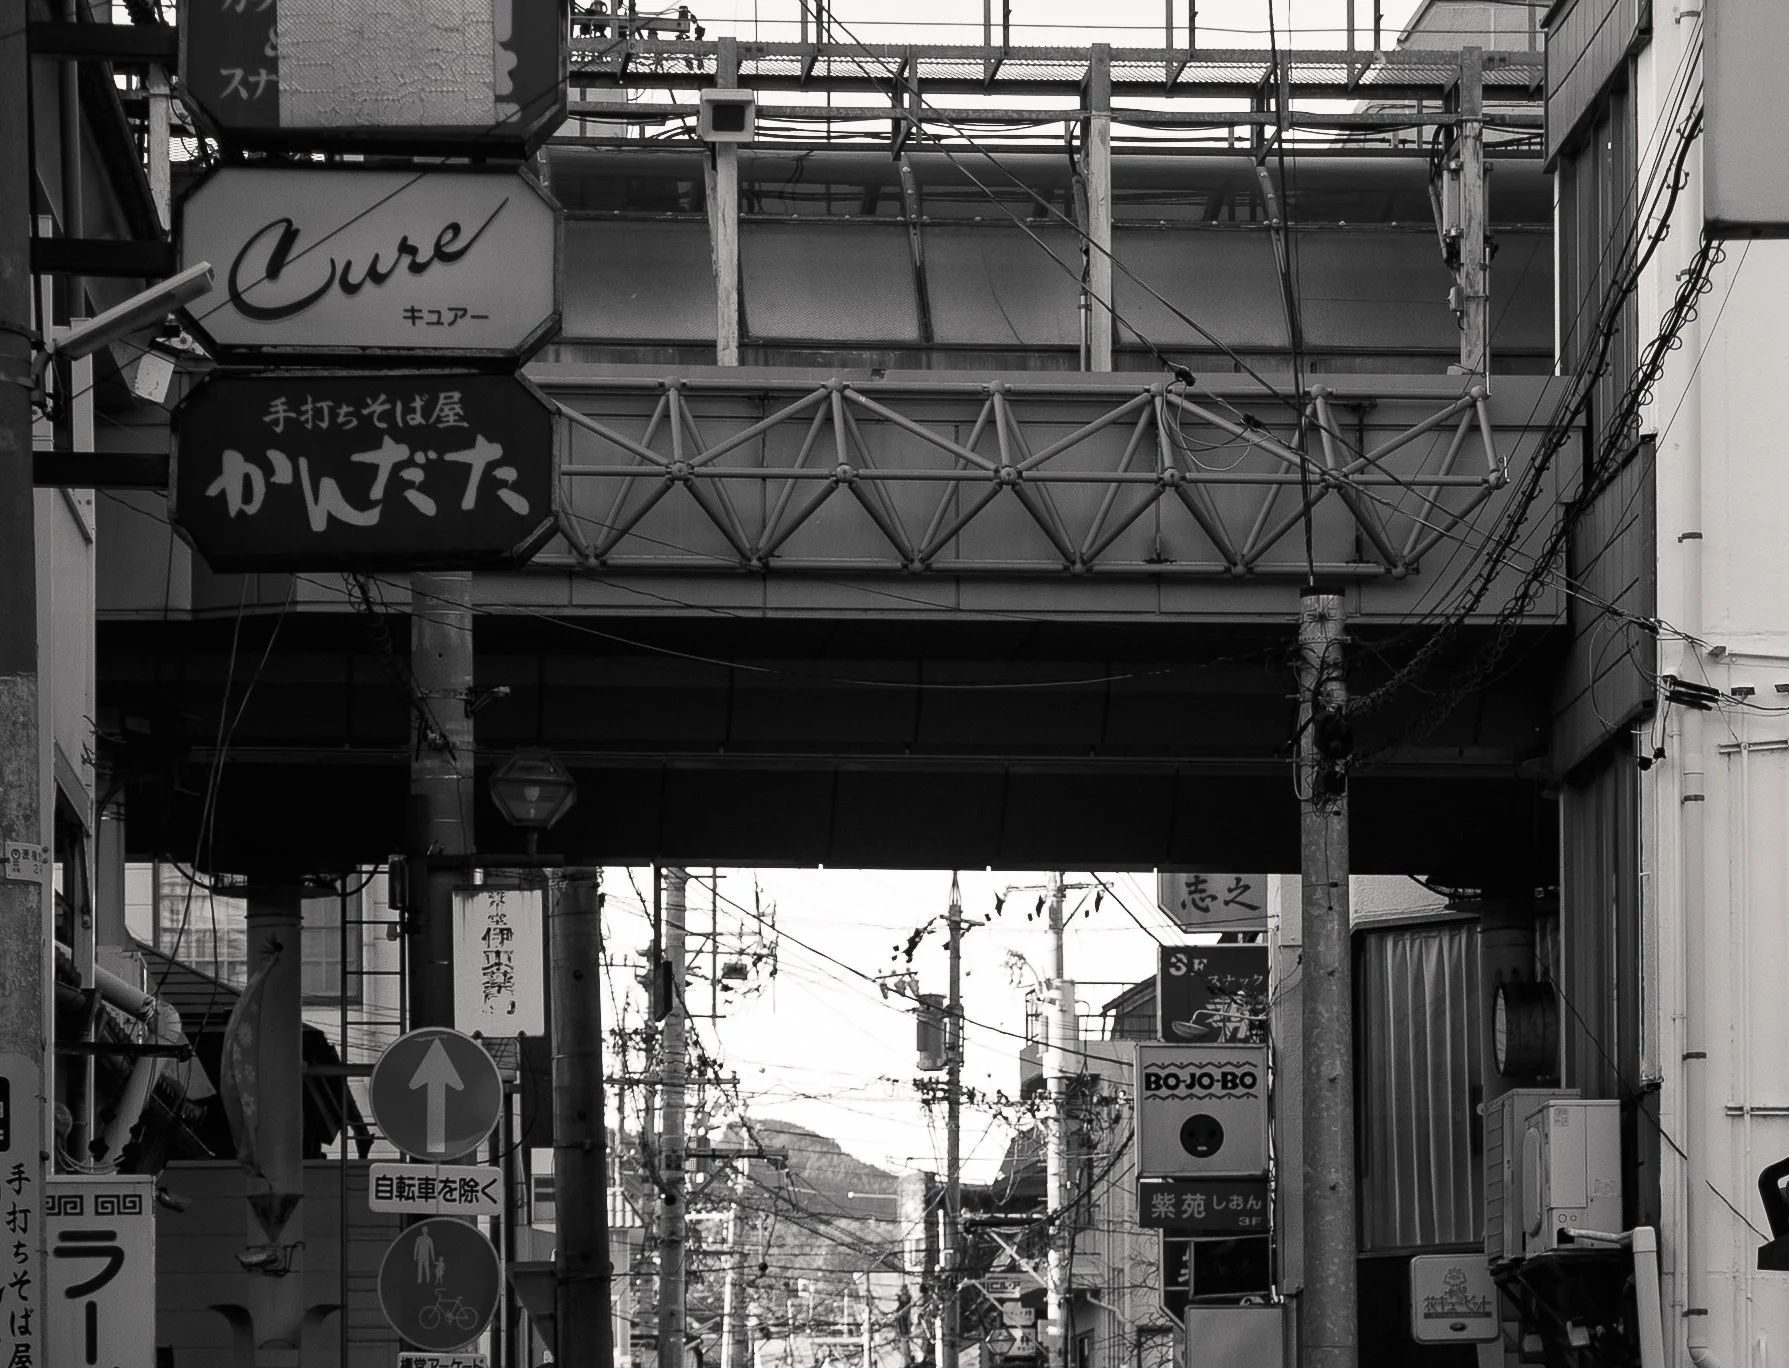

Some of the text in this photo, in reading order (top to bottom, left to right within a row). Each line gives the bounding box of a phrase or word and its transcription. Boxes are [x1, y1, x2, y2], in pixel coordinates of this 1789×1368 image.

[228, 198, 509, 320] Cure
[402, 305, 489, 327] キュアー
[262, 392, 469, 432] 手打ちそば屋
[207, 434, 530, 532] かんだた
[1168, 953, 1208, 977] 3F
[1207, 973, 1264, 986] スナック
[1144, 1071, 1258, 1092] BO-JO-BO
[374, 1174, 498, 1205] 自転車を除く
[1151, 1193, 1262, 1219] 紫苑 しおん
[1238, 1216, 1262, 1226] 3F
